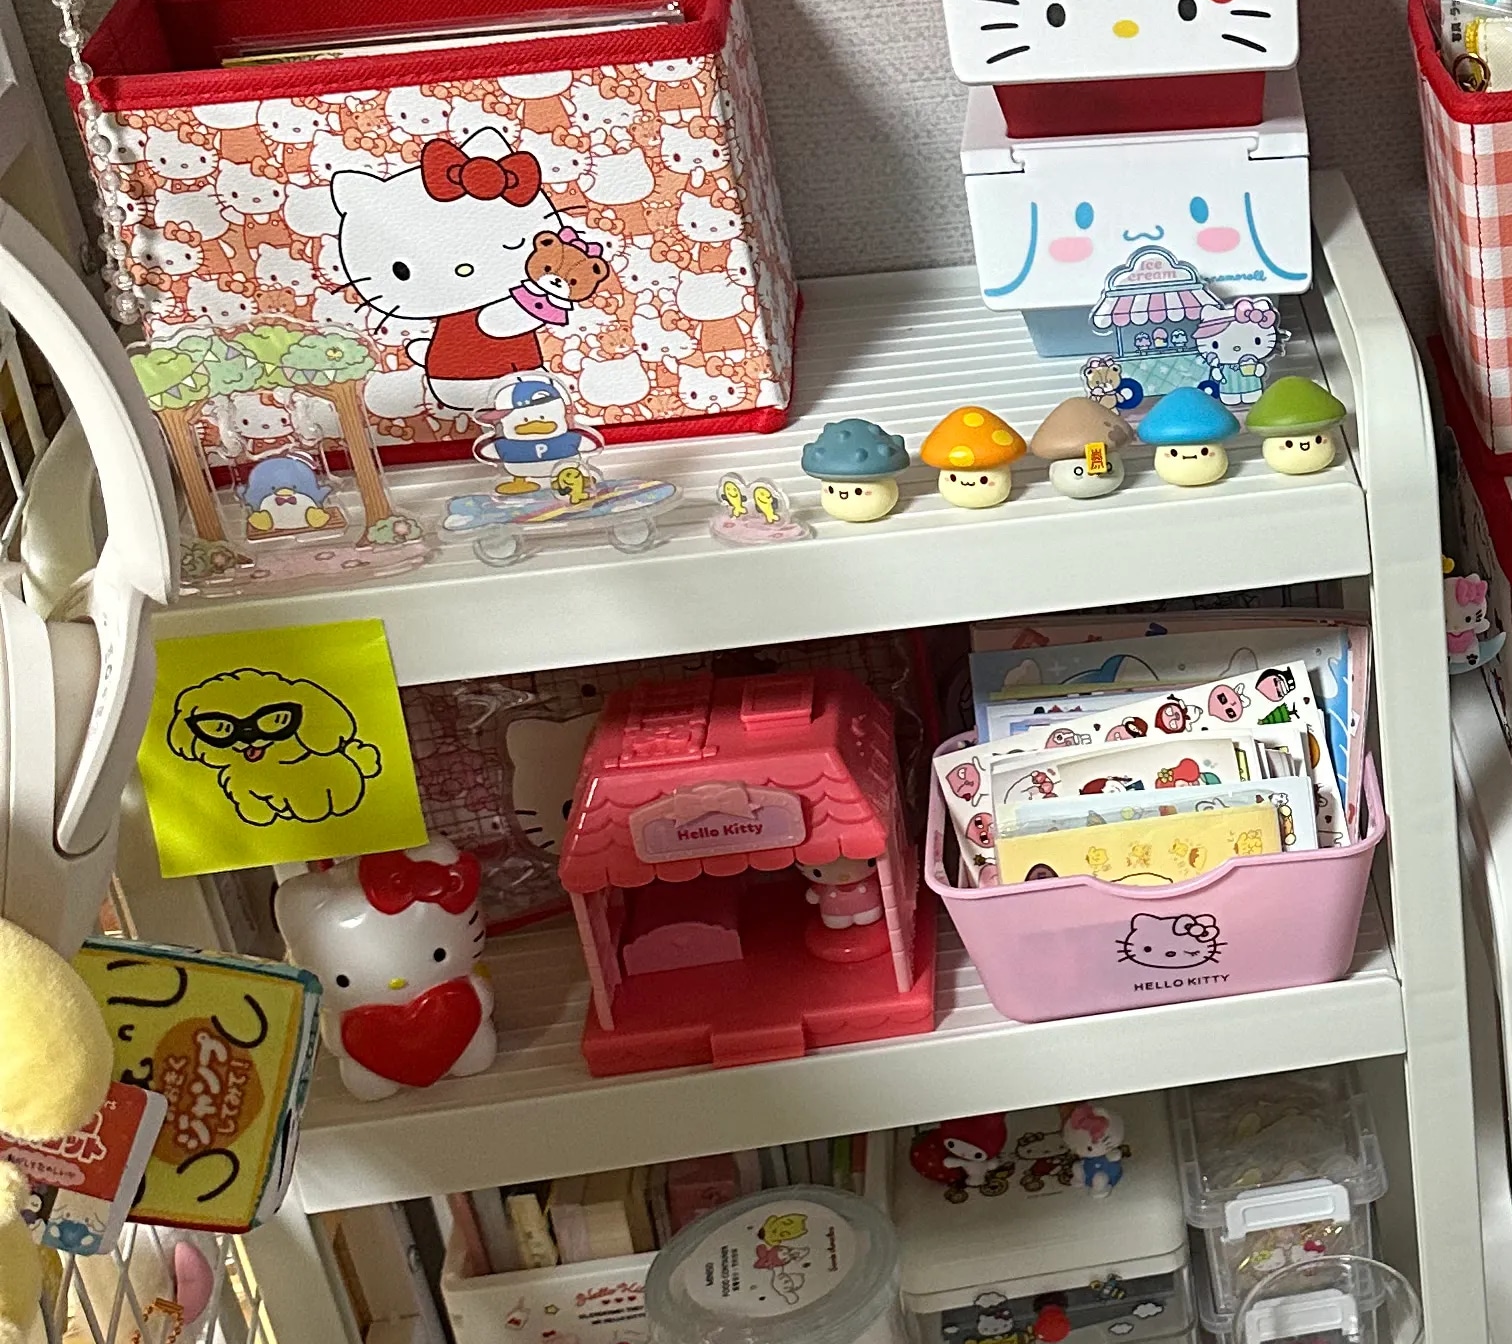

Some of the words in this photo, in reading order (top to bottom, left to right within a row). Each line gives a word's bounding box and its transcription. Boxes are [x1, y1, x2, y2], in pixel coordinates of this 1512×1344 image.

[1140, 260, 1163, 271] Ice
[1127, 270, 1178, 283] cream
[535, 443, 548, 457] P
[677, 824, 720, 842] Hello
[723, 820, 764, 838] Kitty
[1133, 978, 1183, 992] HELLO
[1187, 973, 1231, 987] KITTY
